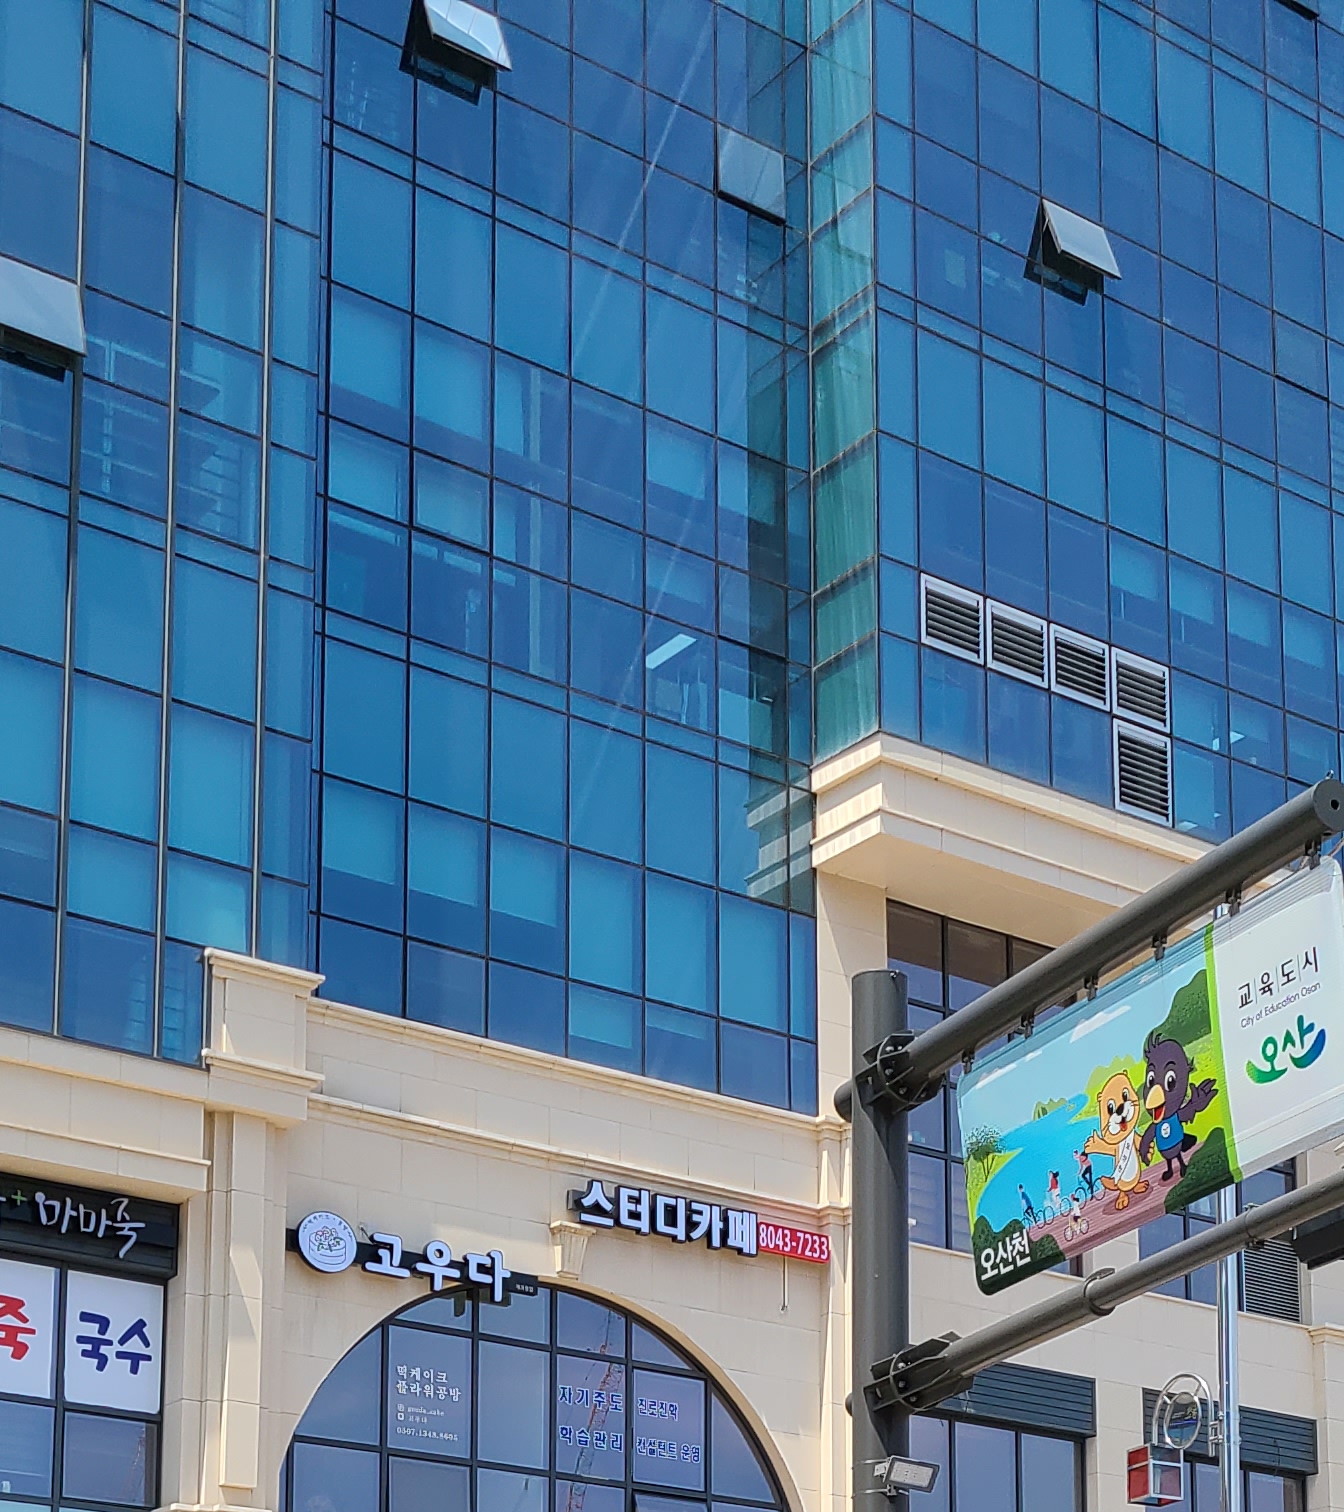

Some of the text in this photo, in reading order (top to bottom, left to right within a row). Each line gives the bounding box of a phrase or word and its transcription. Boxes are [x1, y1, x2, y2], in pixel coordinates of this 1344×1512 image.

[1241, 1015, 1254, 1028] City
[1264, 993, 1300, 1016] Education
[1301, 982, 1321, 998] Osan
[1245, 1014, 1326, 1084] 오산
[578, 1179, 829, 1260] 스터디카페 8043-7233
[365, 1231, 511, 1302] 고우다
[981, 1229, 1031, 1280] 오산천
[76, 1311, 153, 1375] 국수
[397, 1365, 448, 1383] 떡케이크
[559, 1385, 623, 1412] 자기주도
[637, 1398, 679, 1421] 진로진학
[559, 1426, 623, 1452] 학습관리
[681, 1444, 700, 1463] 운영
